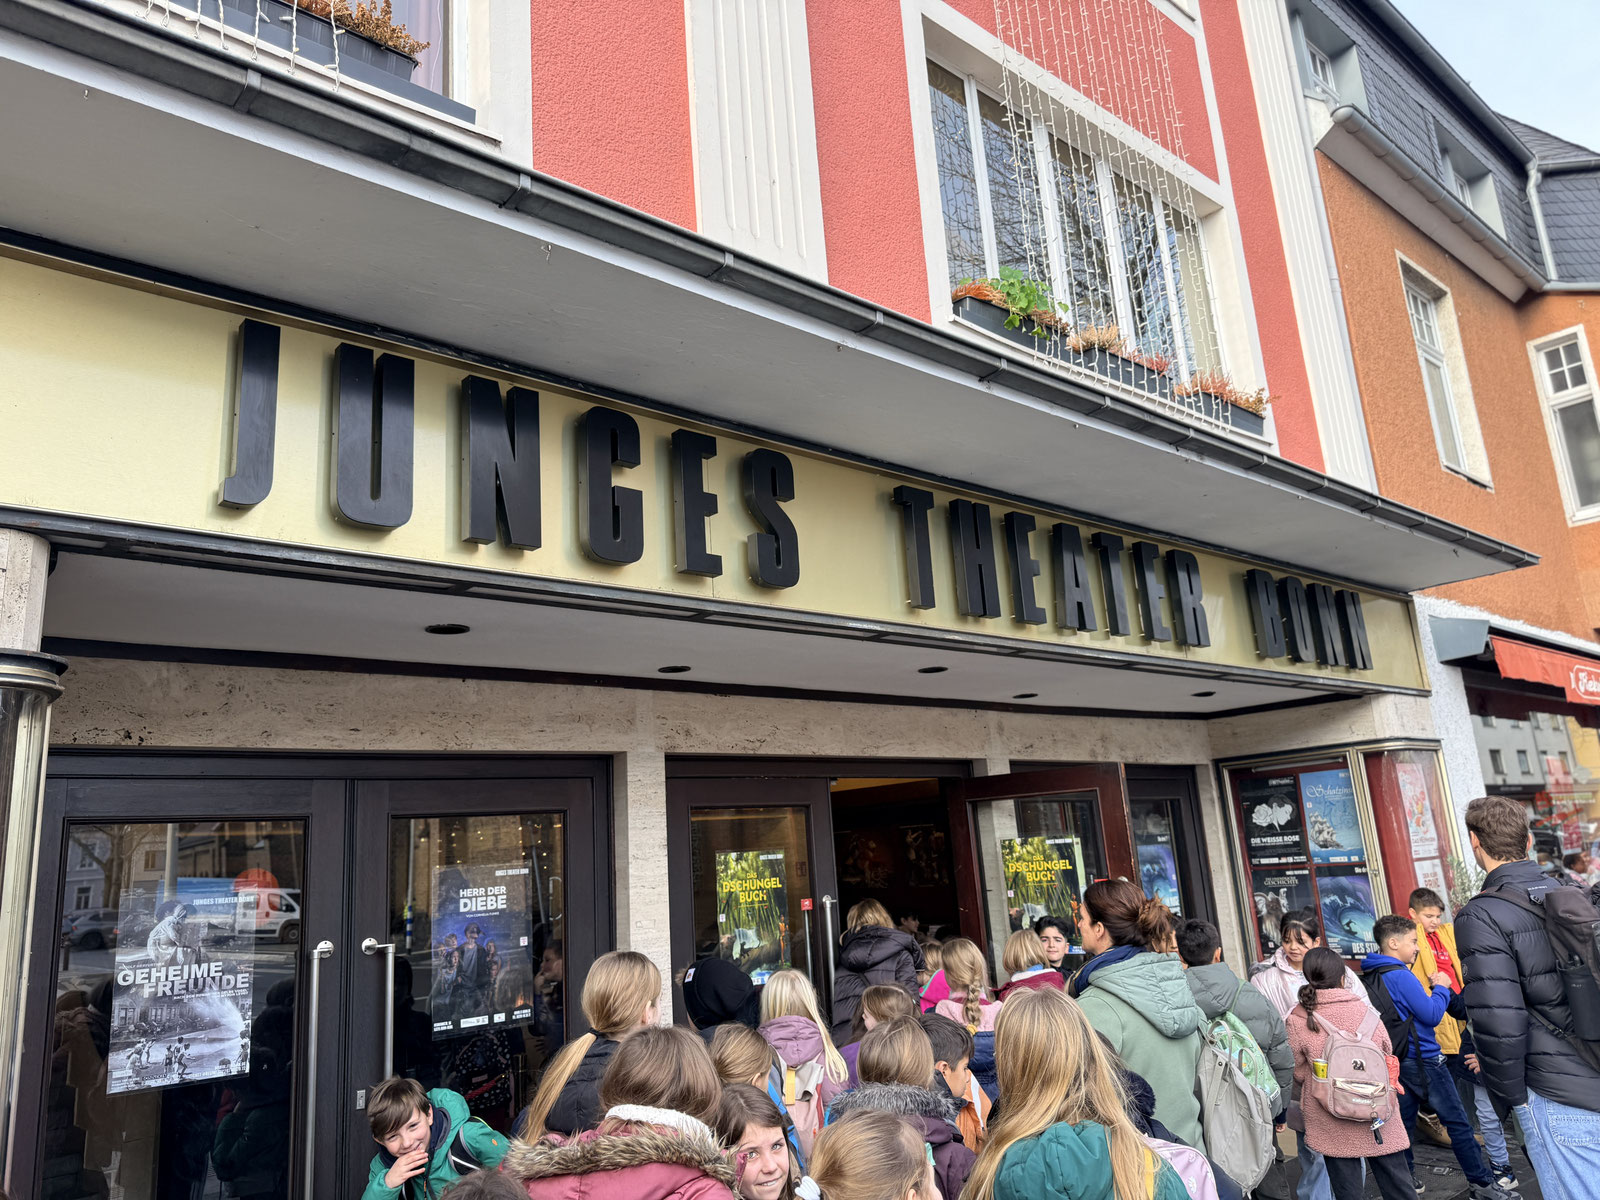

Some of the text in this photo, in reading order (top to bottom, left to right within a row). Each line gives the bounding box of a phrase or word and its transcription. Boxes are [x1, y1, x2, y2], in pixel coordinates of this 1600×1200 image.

[218, 318, 1374, 671] JUNGES THEATER BONN
[1009, 859, 1073, 872] DSCHUNGEL
[1026, 870, 1056, 882] BUCH
[460, 886, 507, 897] HERR DER
[722, 877, 783, 893] DSCHUNGEL
[193, 898, 214, 906] JUNGES
[215, 896, 238, 905] THEATER
[739, 890, 767, 903] BUCH
[459, 895, 507, 912] DIEBE
[1352, 942, 1365, 954] DES
[117, 961, 223, 986] GEHEIME
[143, 973, 250, 998] FREUNDE
